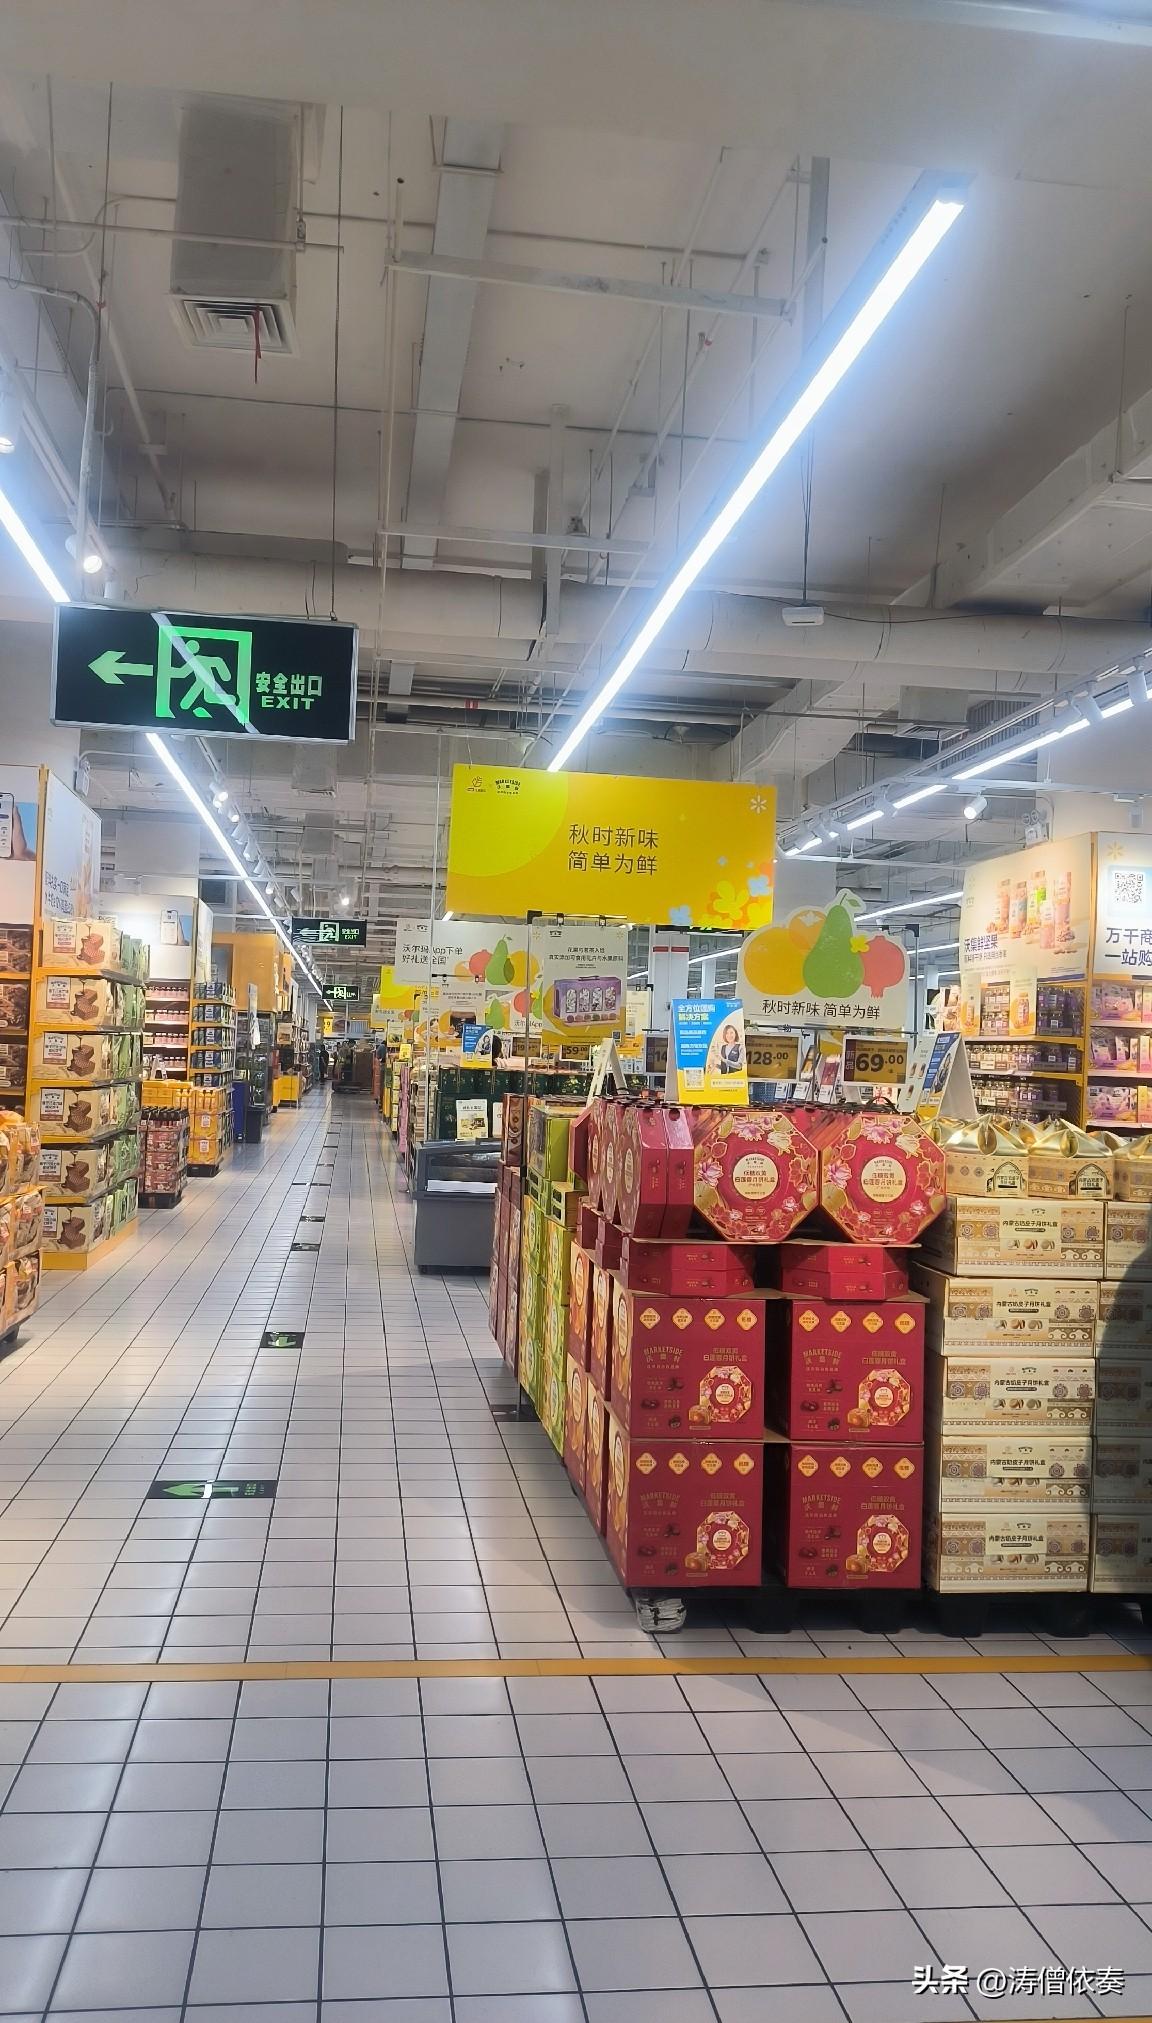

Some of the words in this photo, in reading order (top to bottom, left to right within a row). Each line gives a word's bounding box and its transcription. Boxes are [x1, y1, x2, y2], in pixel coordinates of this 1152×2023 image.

[255, 671, 323, 697] 安全出口
[261, 695, 315, 710] EXIT
[569, 824, 659, 849] 秋时新味
[568, 850, 658, 875] 简单为鲜
[762, 999, 821, 1016] 秋时新味
[823, 1002, 881, 1020] 简单为鲜
[745, 1051, 789, 1066] 128.00
[855, 1053, 904, 1073] 69.00
[643, 1346, 684, 1355] MARKETSIDE
[802, 1494, 841, 1504] MARKETSIDE
